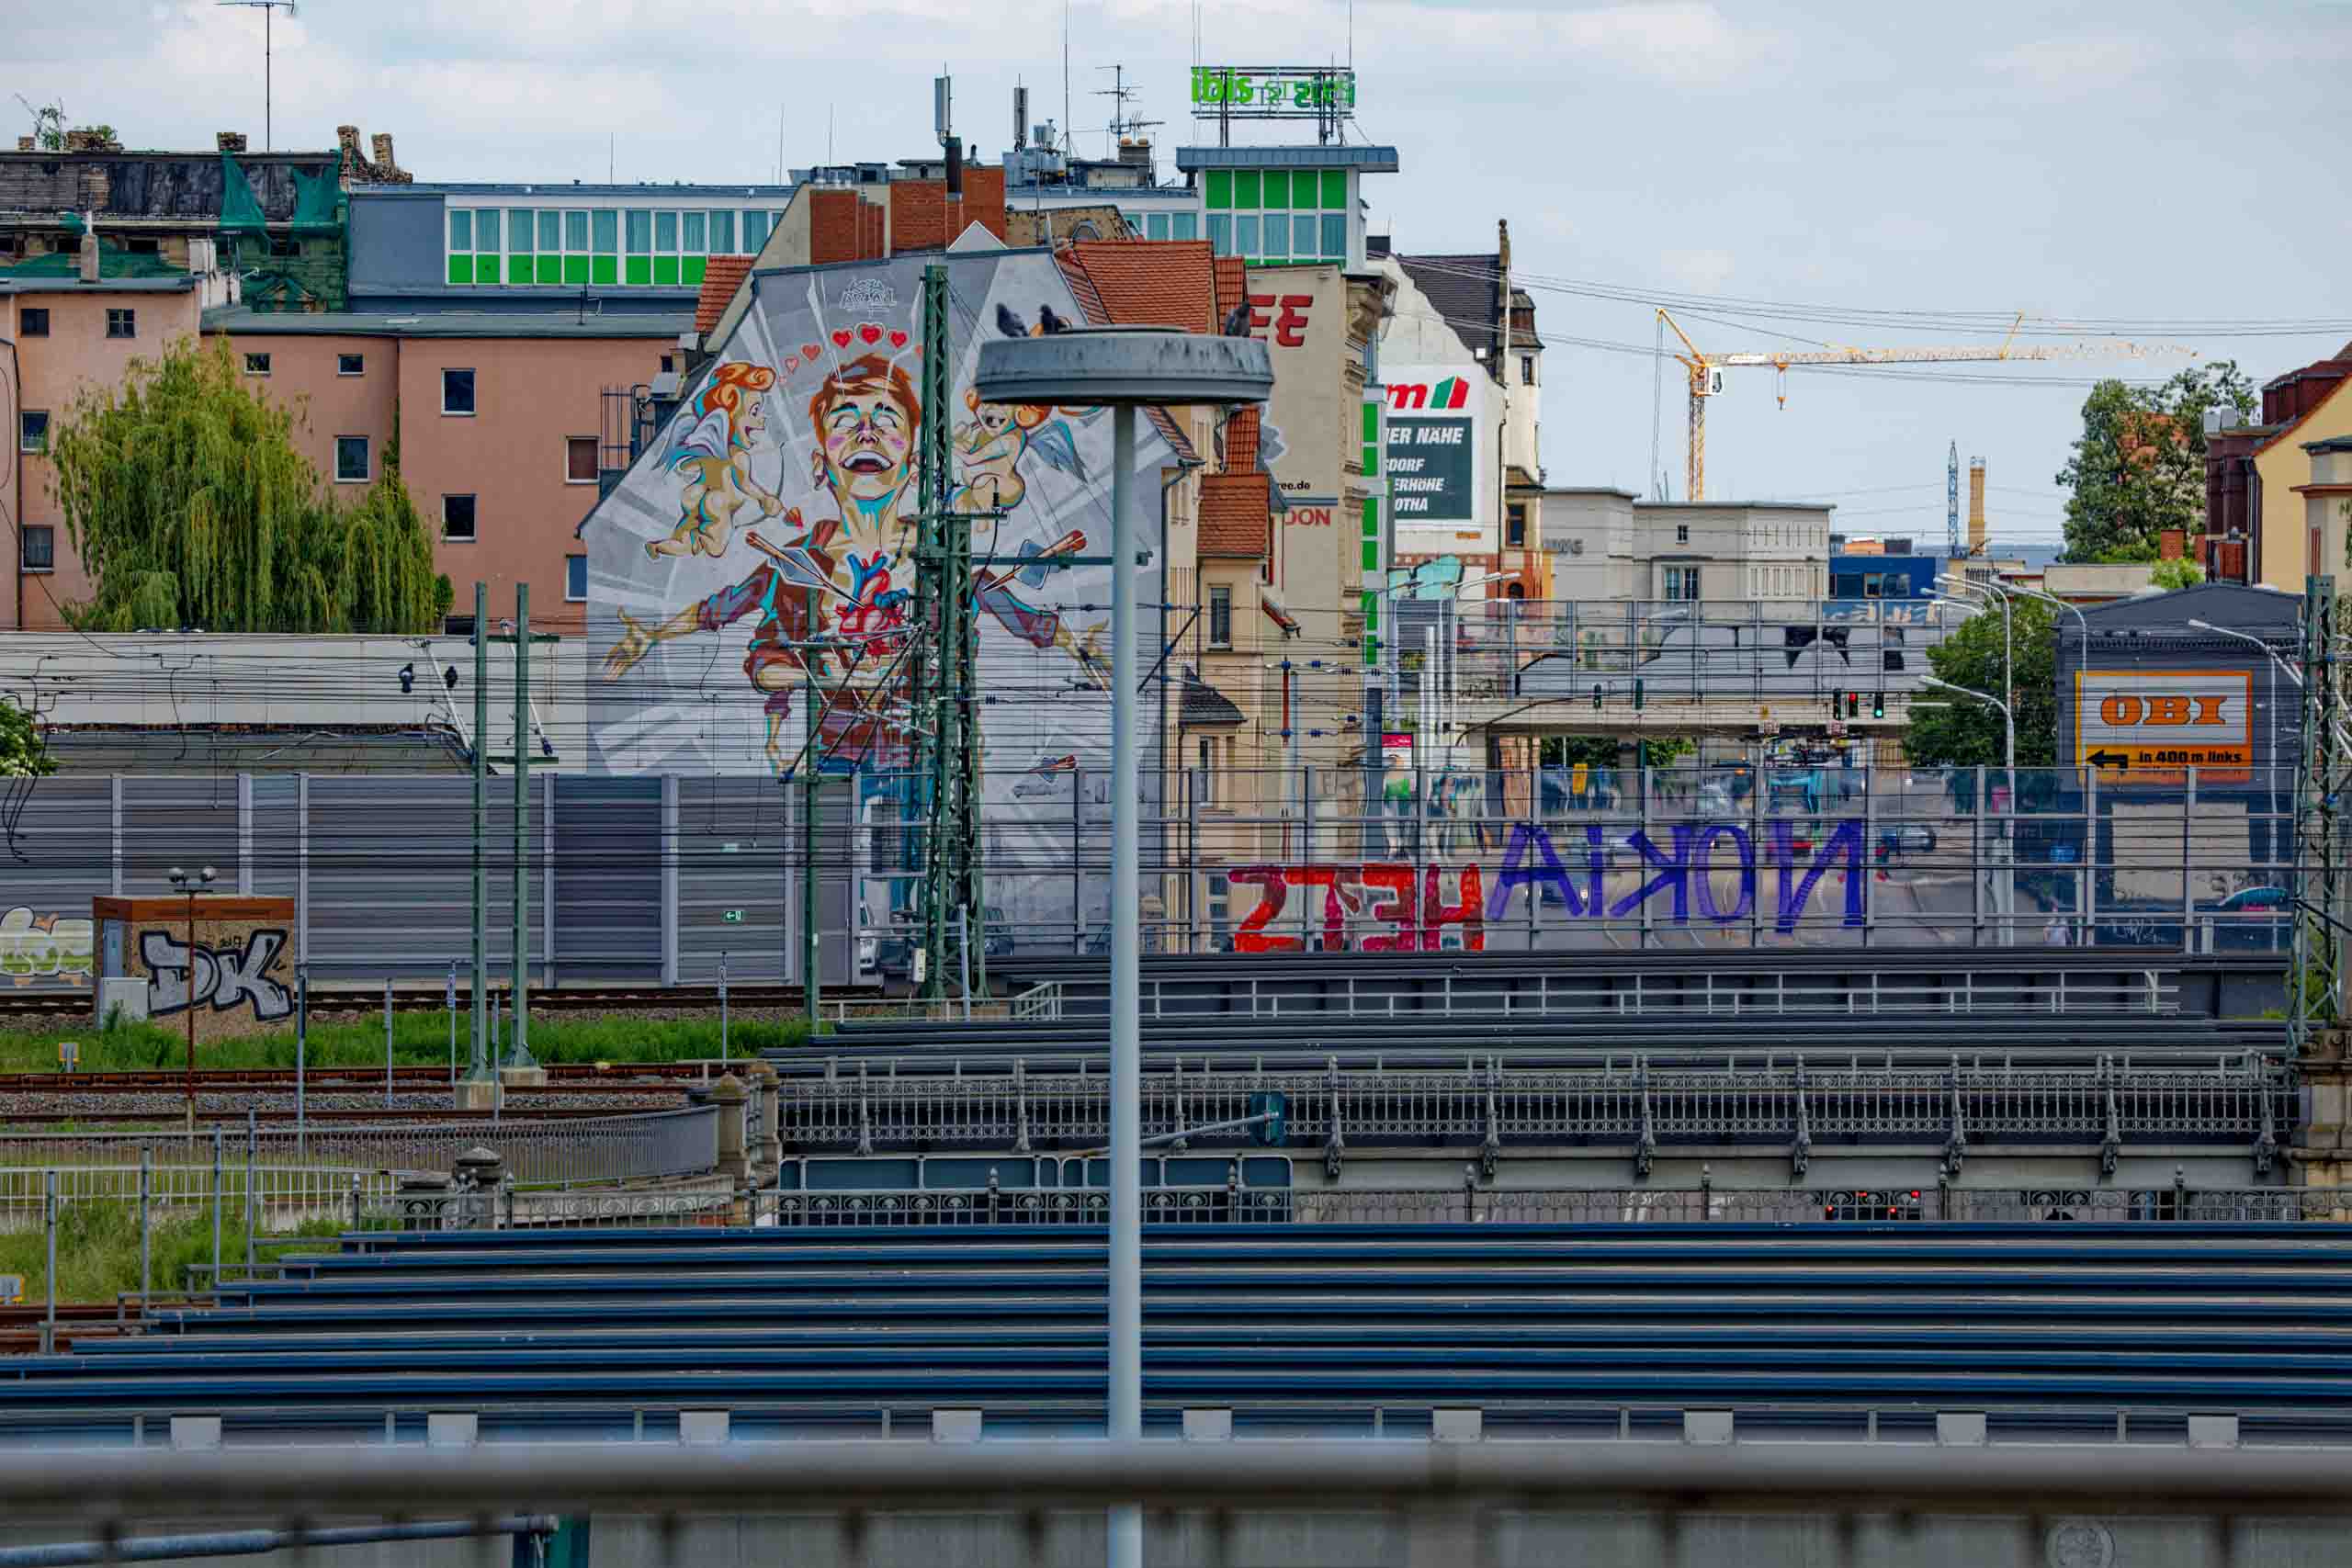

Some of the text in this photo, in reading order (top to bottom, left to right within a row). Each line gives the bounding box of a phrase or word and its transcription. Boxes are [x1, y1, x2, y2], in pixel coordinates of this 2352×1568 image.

[1191, 66, 1253, 104] ibis
[1416, 426, 1464, 445] NÄHE
[2100, 695, 2228, 726] OBI
[2139, 750, 2243, 764] in 400 m links
